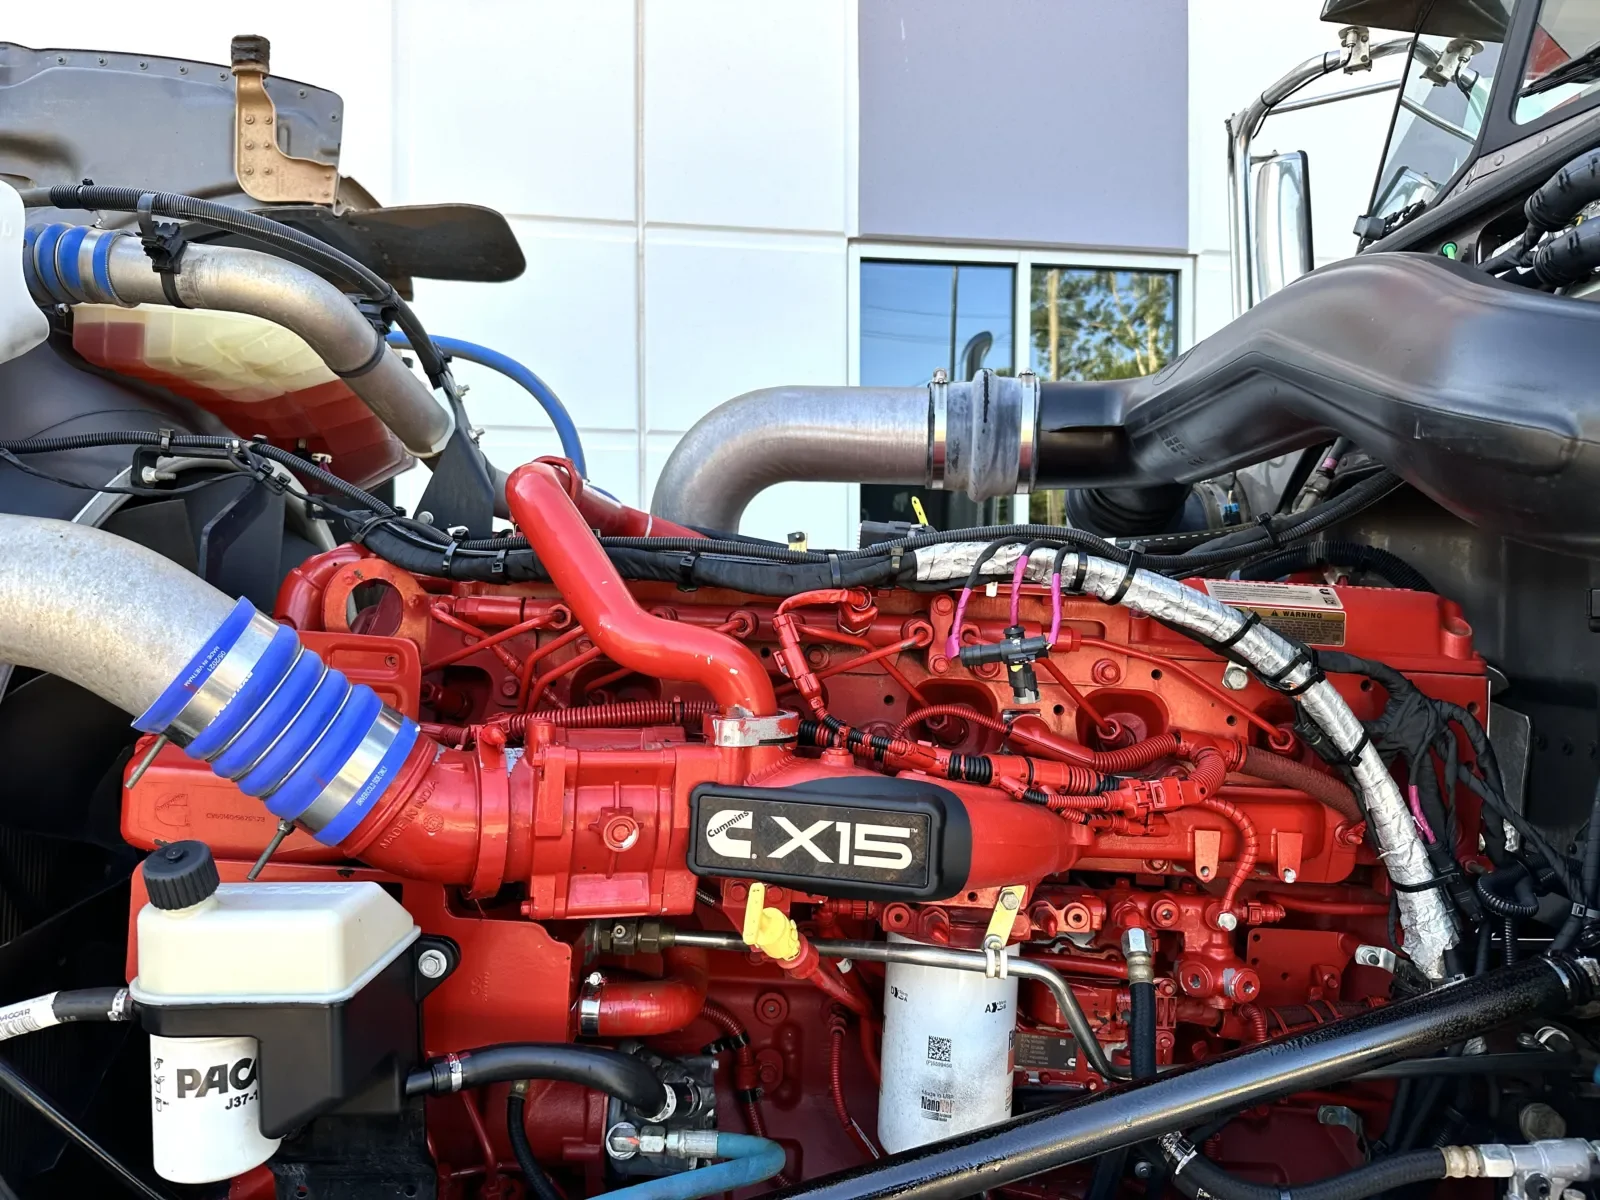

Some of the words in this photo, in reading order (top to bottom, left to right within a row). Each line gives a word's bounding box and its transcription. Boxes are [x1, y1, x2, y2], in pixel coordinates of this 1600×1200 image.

[1283, 611, 1323, 619] WARNING
[207, 646, 220, 660] MADE
[207, 651, 226, 672] 05/2021
[184, 666, 204, 687] VIETNAM
[380, 820, 406, 849] MADE
[404, 809, 418, 823] IN
[414, 781, 440, 809] INDIA
[707, 811, 750, 838] Cummins
[766, 815, 913, 870] X15
[0, 1008, 30, 1021] ACCAR
[177, 1057, 257, 1098] PAC
